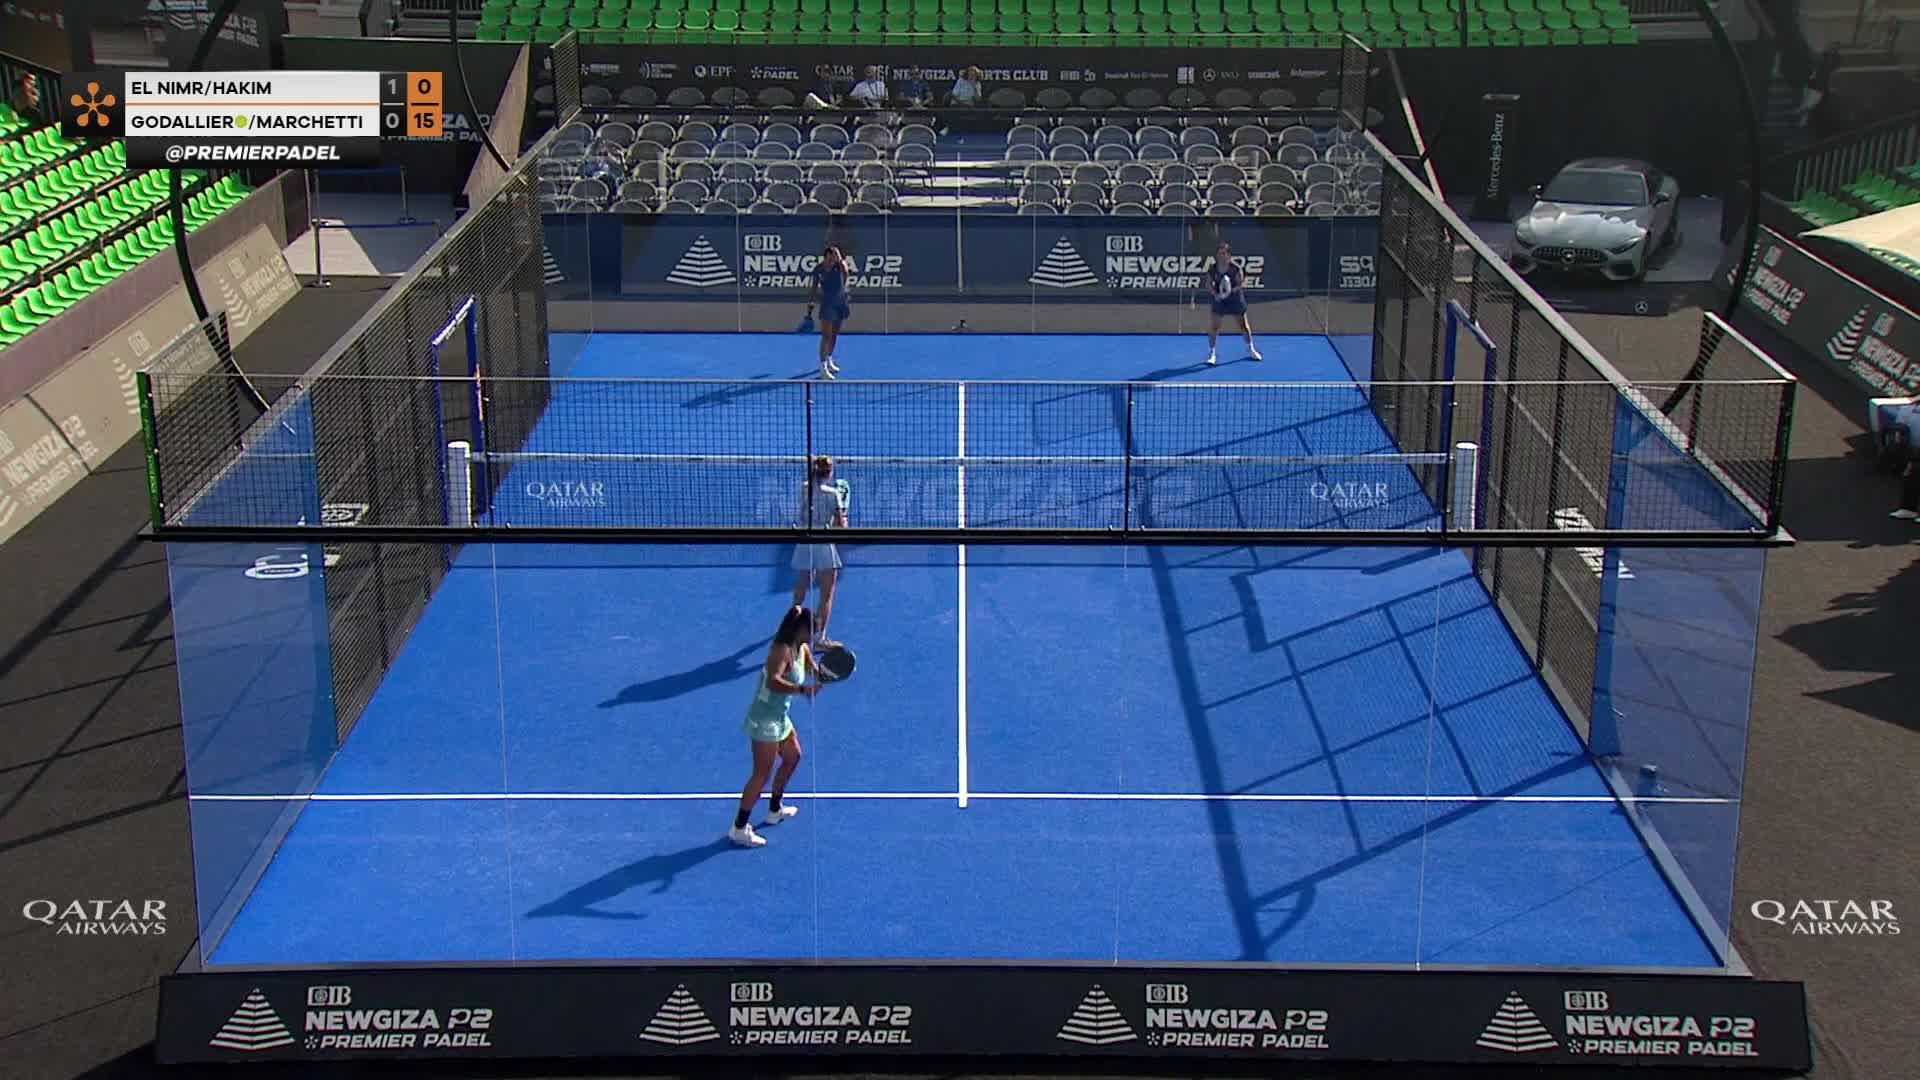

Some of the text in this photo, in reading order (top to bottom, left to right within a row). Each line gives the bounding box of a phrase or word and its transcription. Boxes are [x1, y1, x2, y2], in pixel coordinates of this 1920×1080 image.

[1013, 69, 1048, 80] CLUB
[744, 255, 902, 272] NEWGA P2
[1120, 276, 1200, 288] PREMIER
[526, 481, 604, 497] QATAR
[1310, 482, 1389, 499] QATAR
[22, 900, 167, 923] QATAR
[1751, 900, 1897, 925] QATAR
[56, 921, 167, 936] AIRWAYS
[1791, 920, 1900, 935] AIRWAYS
[305, 1008, 493, 1031] NEWGIZA P2
[730, 1005, 912, 1027] NEWGIZA P2
[1146, 1008, 1328, 1030] NEWGIZA P2
[1566, 1015, 1756, 1039] NEWGIZA P2
[320, 1032, 491, 1049] PREMIER PADEL
[745, 1030, 911, 1044] PREMIER PADEL
[1163, 1032, 1328, 1049] PREMIER PADEL
[1584, 1040, 1758, 1056] PREMIER PADEL
